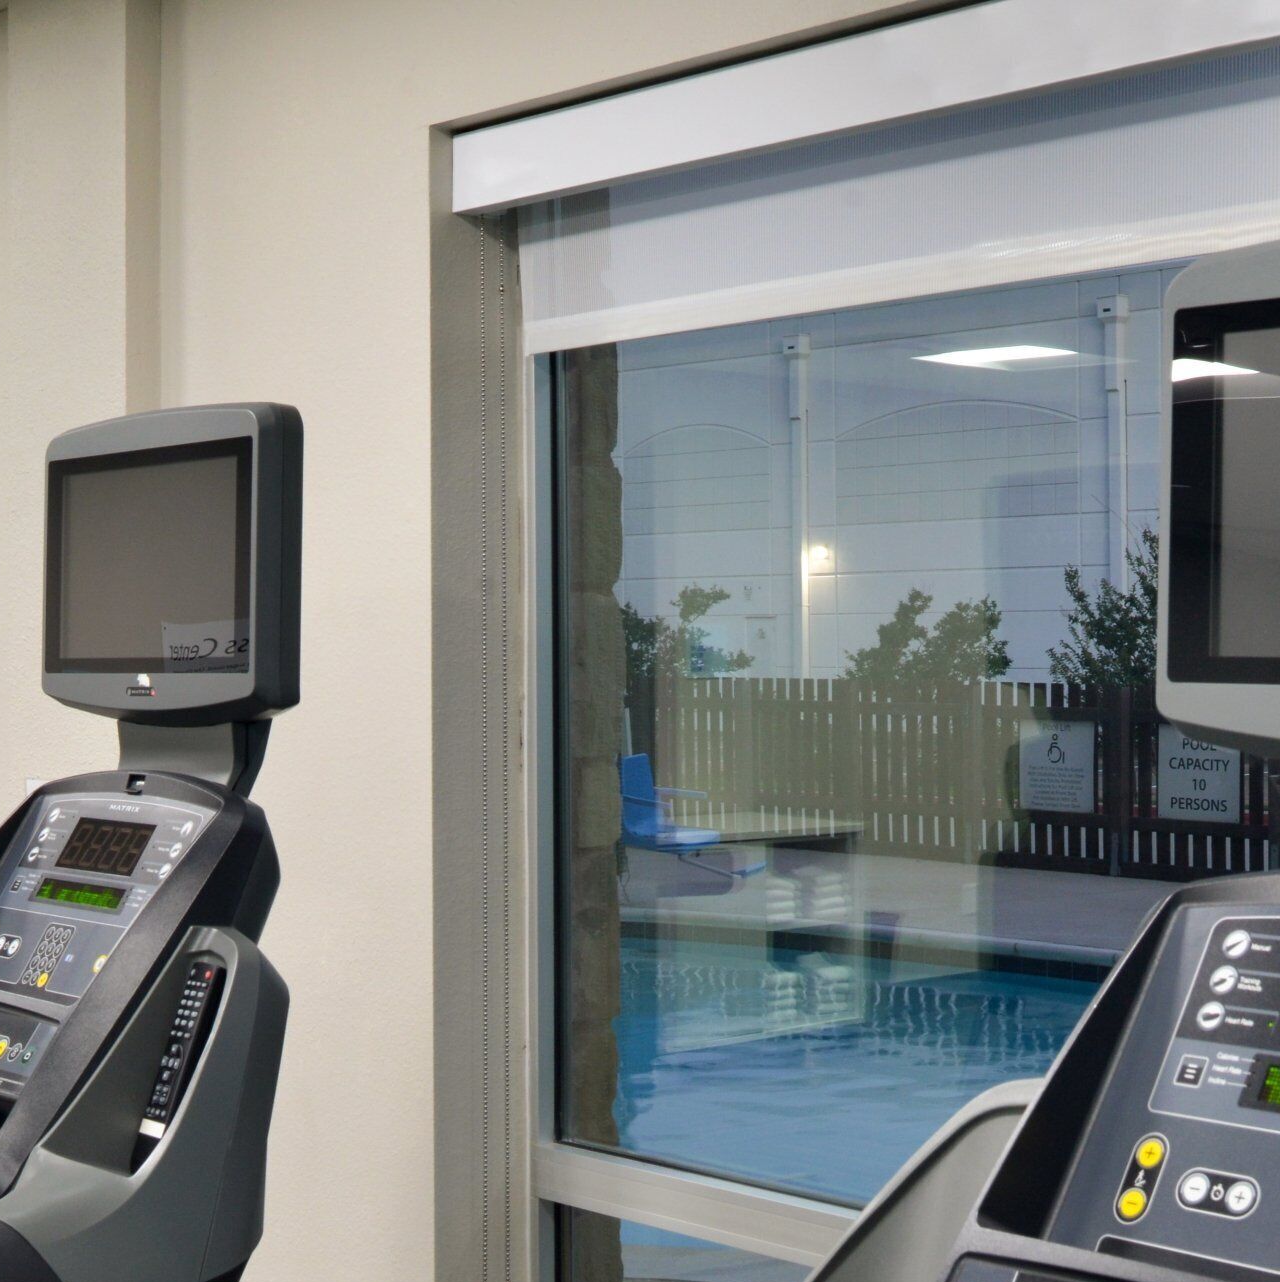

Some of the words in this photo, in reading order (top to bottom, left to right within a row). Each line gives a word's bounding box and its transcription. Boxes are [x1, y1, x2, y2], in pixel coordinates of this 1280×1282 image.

[1169, 757, 1230, 772] CAPACITY
[1192, 779, 1207, 791] 10
[109, 804, 140, 813] MATRIX
[1170, 797, 1228, 812] PERSONS
